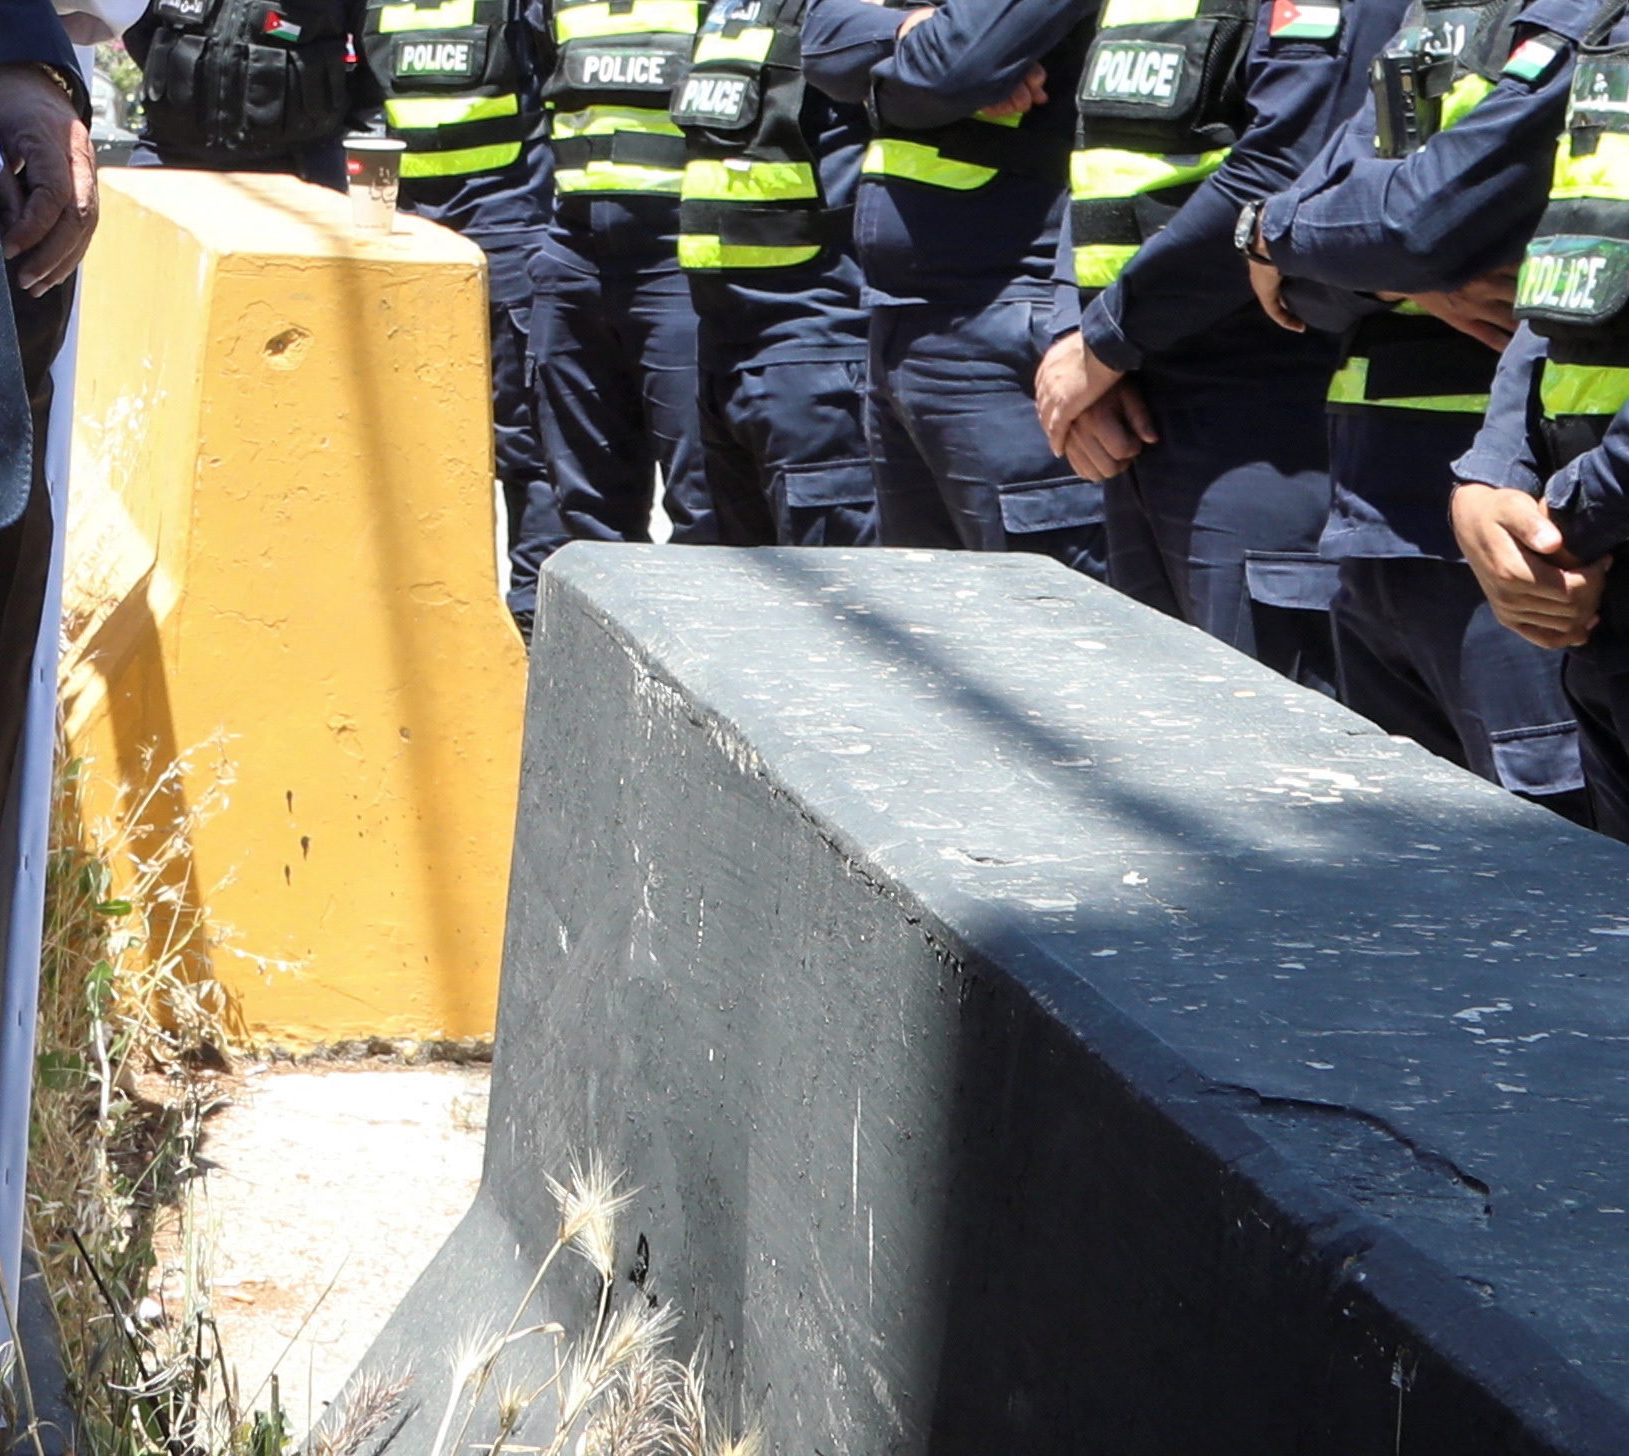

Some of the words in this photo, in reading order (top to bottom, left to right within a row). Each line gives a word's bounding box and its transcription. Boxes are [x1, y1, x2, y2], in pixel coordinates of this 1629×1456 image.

[401, 44, 468, 73] POLICE
[583, 55, 666, 84] POLICE
[1091, 50, 1180, 97] POLICE
